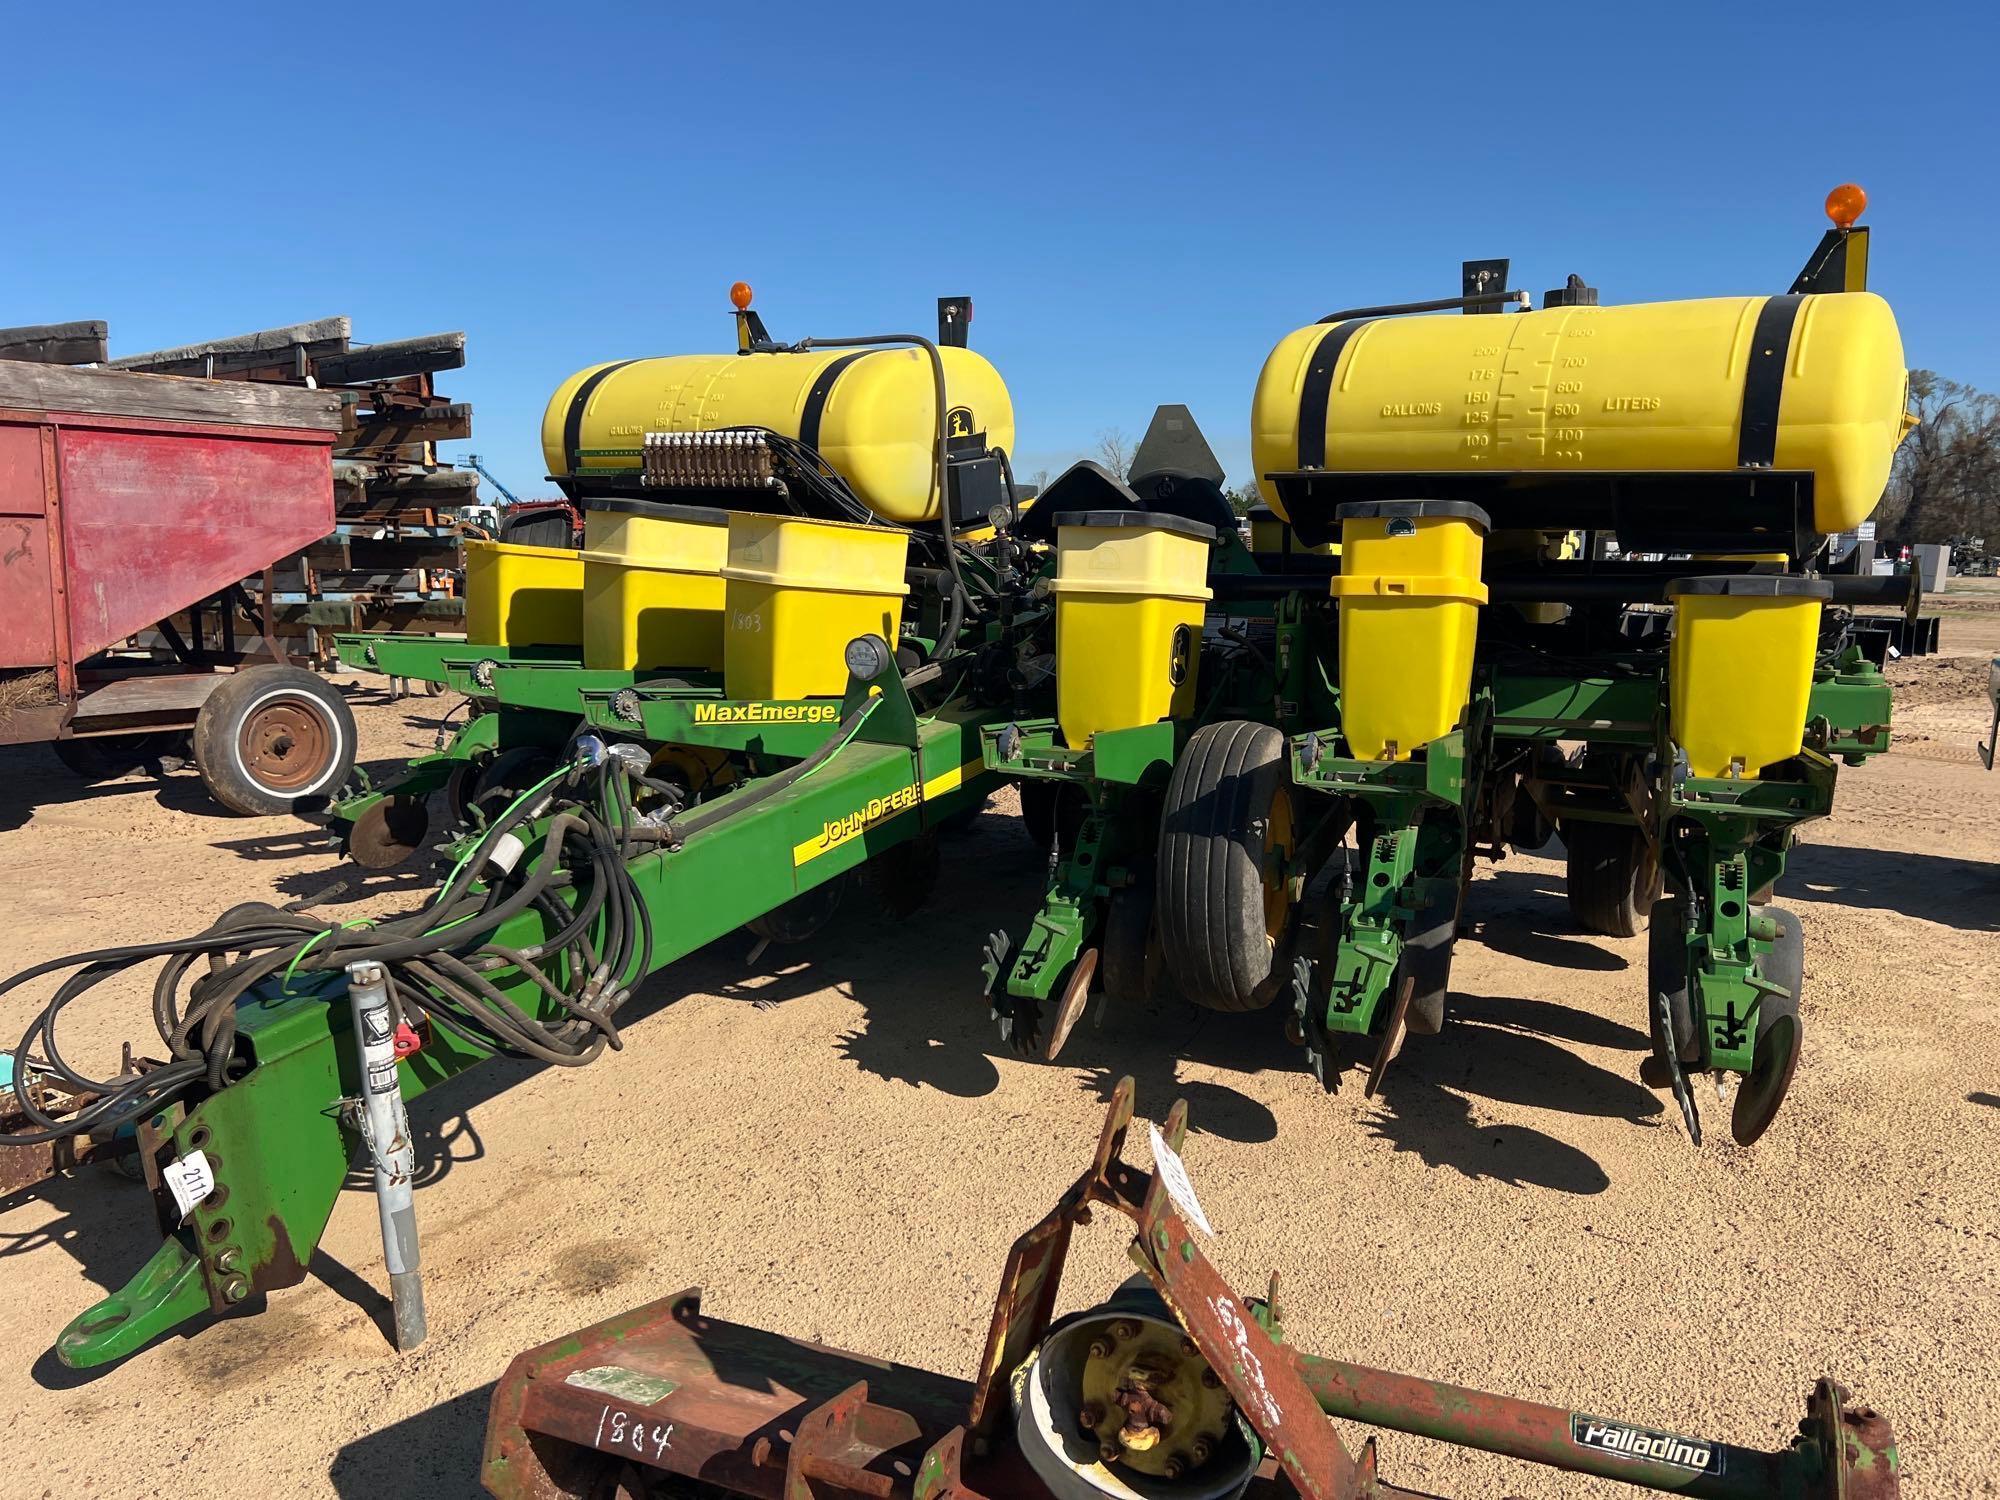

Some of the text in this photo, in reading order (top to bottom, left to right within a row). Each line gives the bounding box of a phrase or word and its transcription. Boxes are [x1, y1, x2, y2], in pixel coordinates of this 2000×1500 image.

[1560, 356, 1588, 369] 700
[1469, 368, 1495, 381] 175
[1555, 381, 1583, 394] 600
[1465, 391, 1490, 404] 150
[1602, 396, 1661, 412] LITERS
[1381, 402, 1442, 417] GALLONS
[1553, 403, 1581, 417] 500
[1465, 411, 1489, 424] 125
[1466, 434, 1489, 447] 100
[1554, 429, 1584, 441] 400
[731, 609, 761, 632] 1803
[694, 703, 837, 723] MaxEmerge
[819, 807, 868, 848] JOHN
[182, 1167, 208, 1201] 2111
[594, 1405, 675, 1460] 1804
[1584, 1420, 1711, 1468] Palladino
